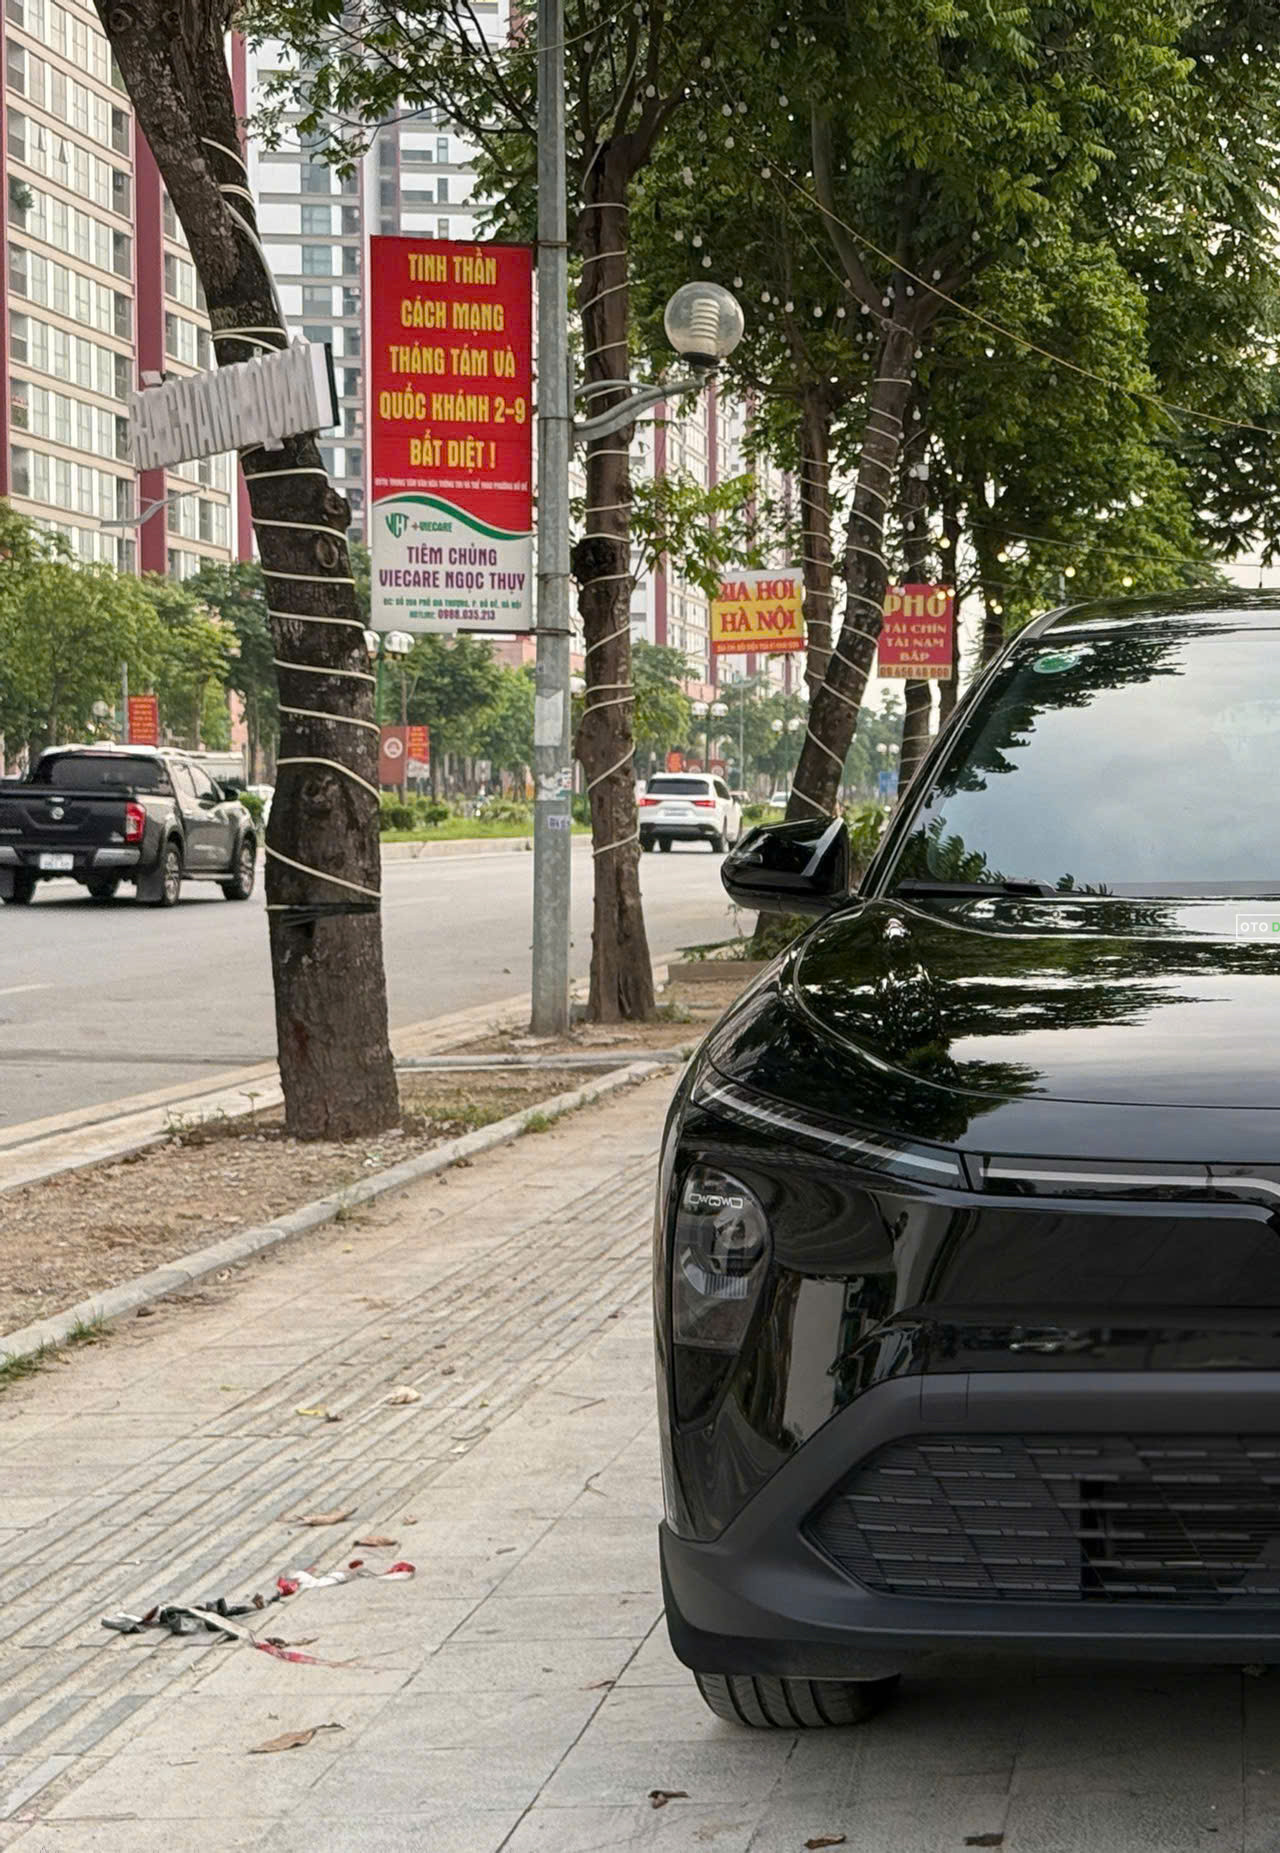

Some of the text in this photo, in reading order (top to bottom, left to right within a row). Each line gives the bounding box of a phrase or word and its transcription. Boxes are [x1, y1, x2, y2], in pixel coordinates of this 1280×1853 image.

[408, 246, 497, 285] TINH THẦN
[401, 295, 505, 336] CÁCH MẠNG
[389, 341, 516, 378] THÁNG TÁM VÀ
[379, 381, 526, 424] QUỐC KHÁNH 2-9
[409, 428, 443, 467] BẤT
[447, 434, 485, 473] DIỆT
[407, 542, 497, 566] TIÊM CHỦNG
[379, 569, 440, 588] VIECARE
[445, 571, 484, 593] NGỌC
[720, 604, 796, 635] HÀ NỘI
